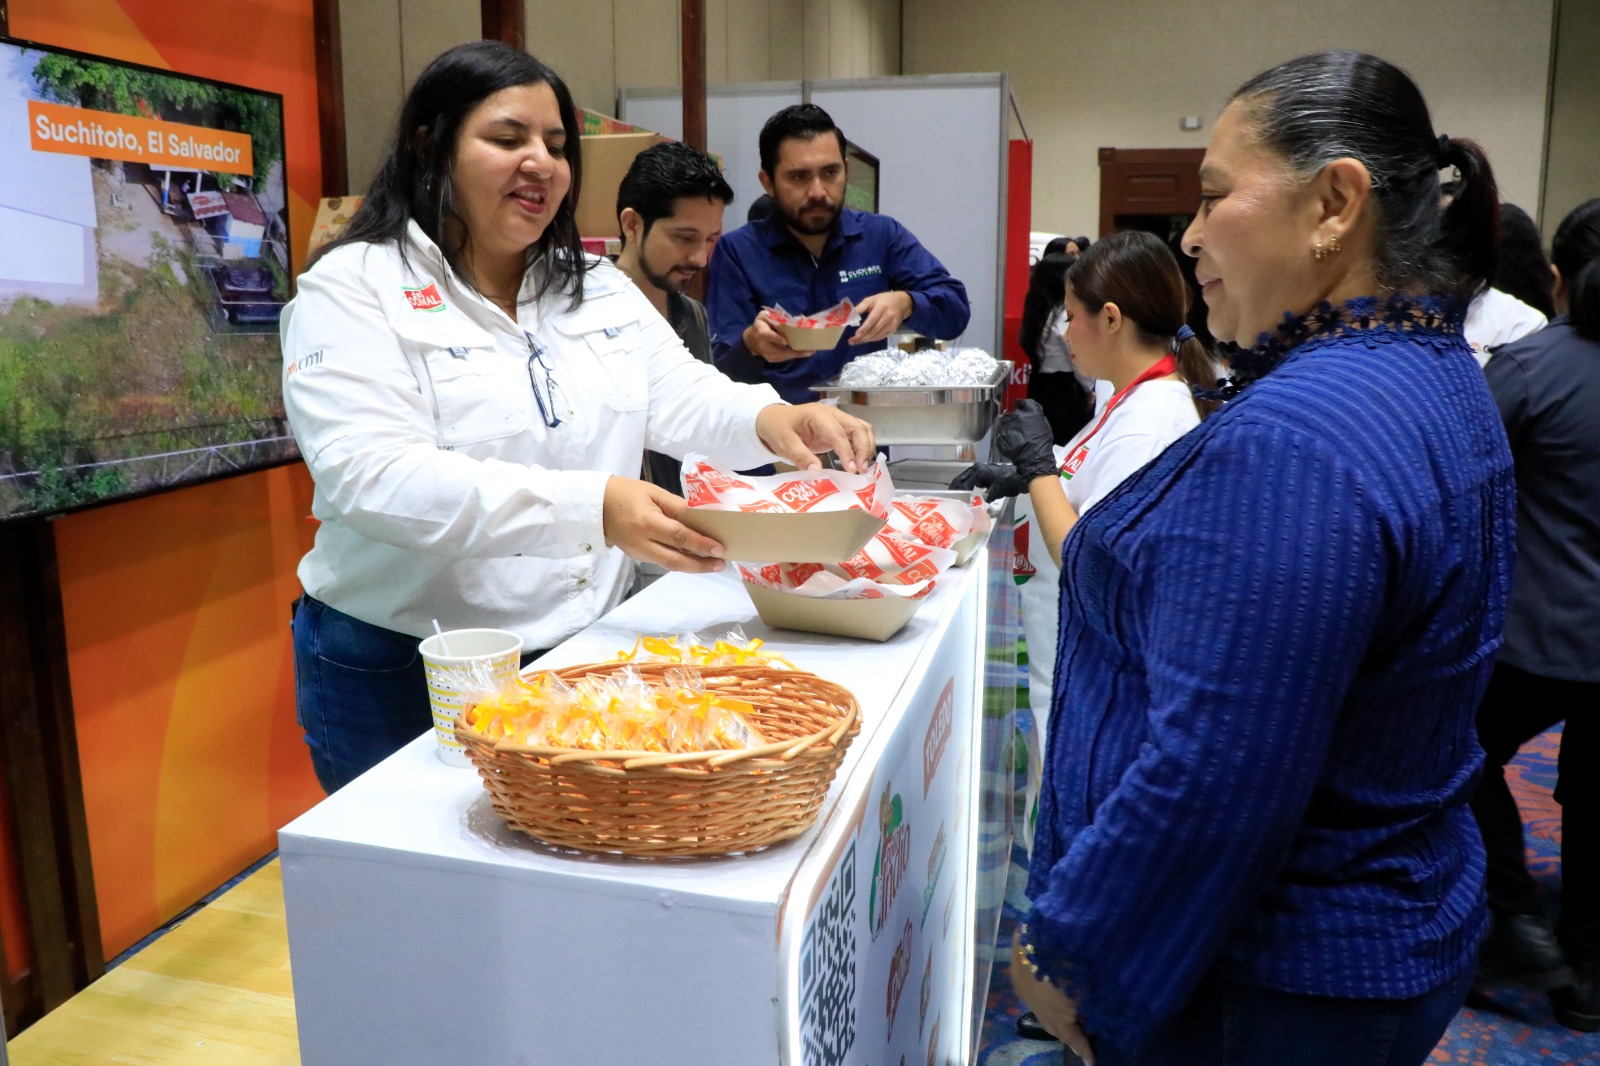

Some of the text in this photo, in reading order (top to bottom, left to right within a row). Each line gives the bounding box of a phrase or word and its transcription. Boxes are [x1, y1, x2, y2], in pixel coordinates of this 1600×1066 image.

[36, 114, 240, 164] Suchitoto, El Salvador
[925, 692, 952, 775] TOLEDO
